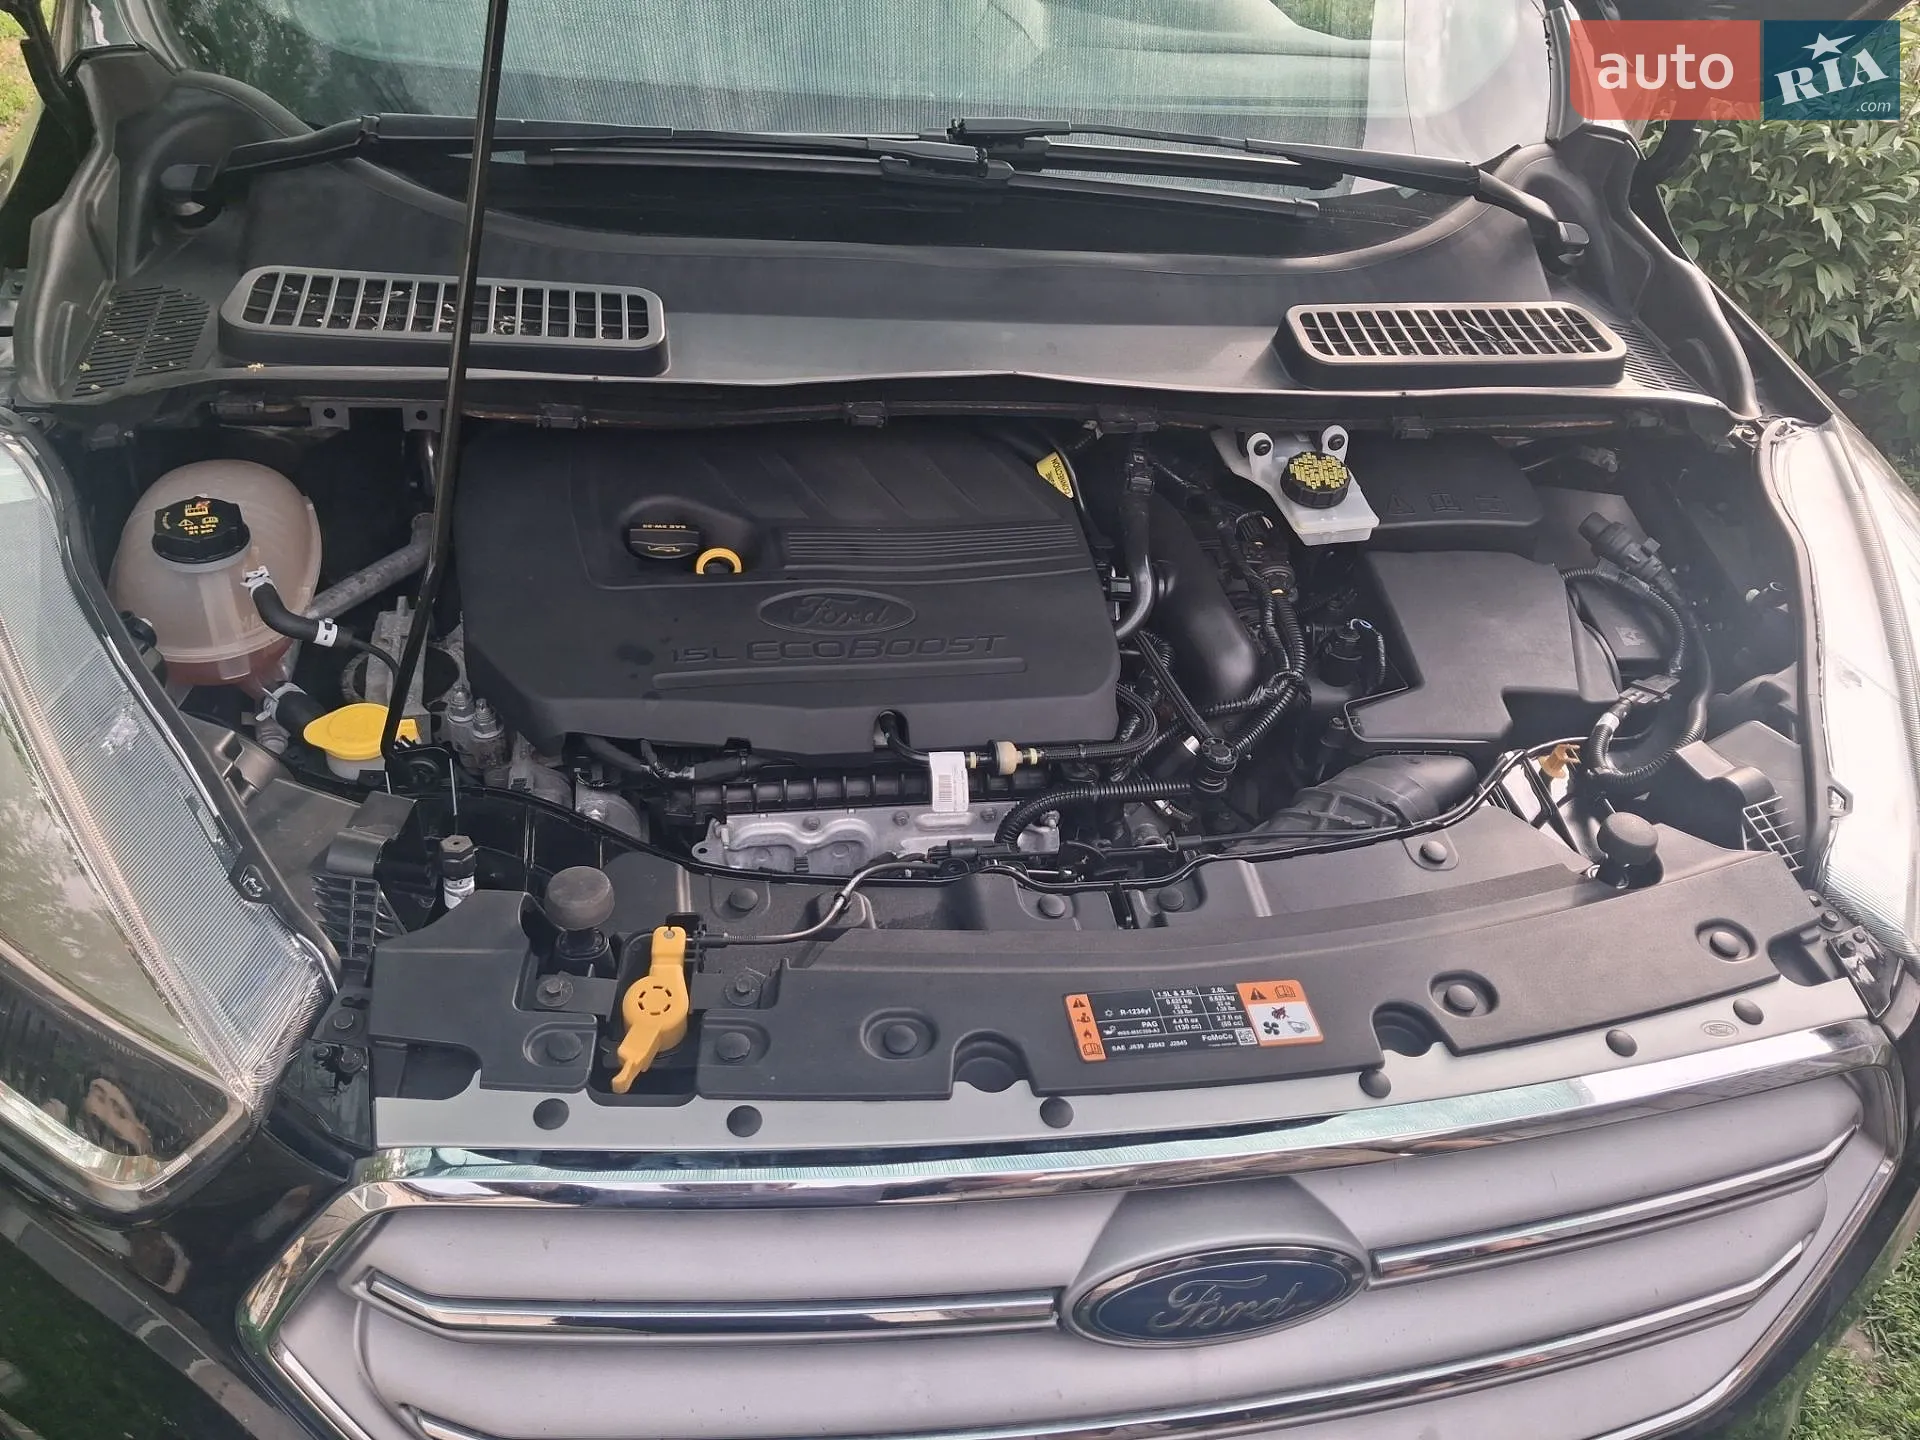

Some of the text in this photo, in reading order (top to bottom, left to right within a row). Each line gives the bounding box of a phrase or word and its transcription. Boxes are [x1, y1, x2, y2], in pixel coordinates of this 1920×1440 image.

[787, 592, 893, 628] Ford
[1111, 1044, 1127, 1052] SAE
[1201, 1033, 1234, 1041] FoMoCo
[1151, 1274, 1304, 1333] Ford
